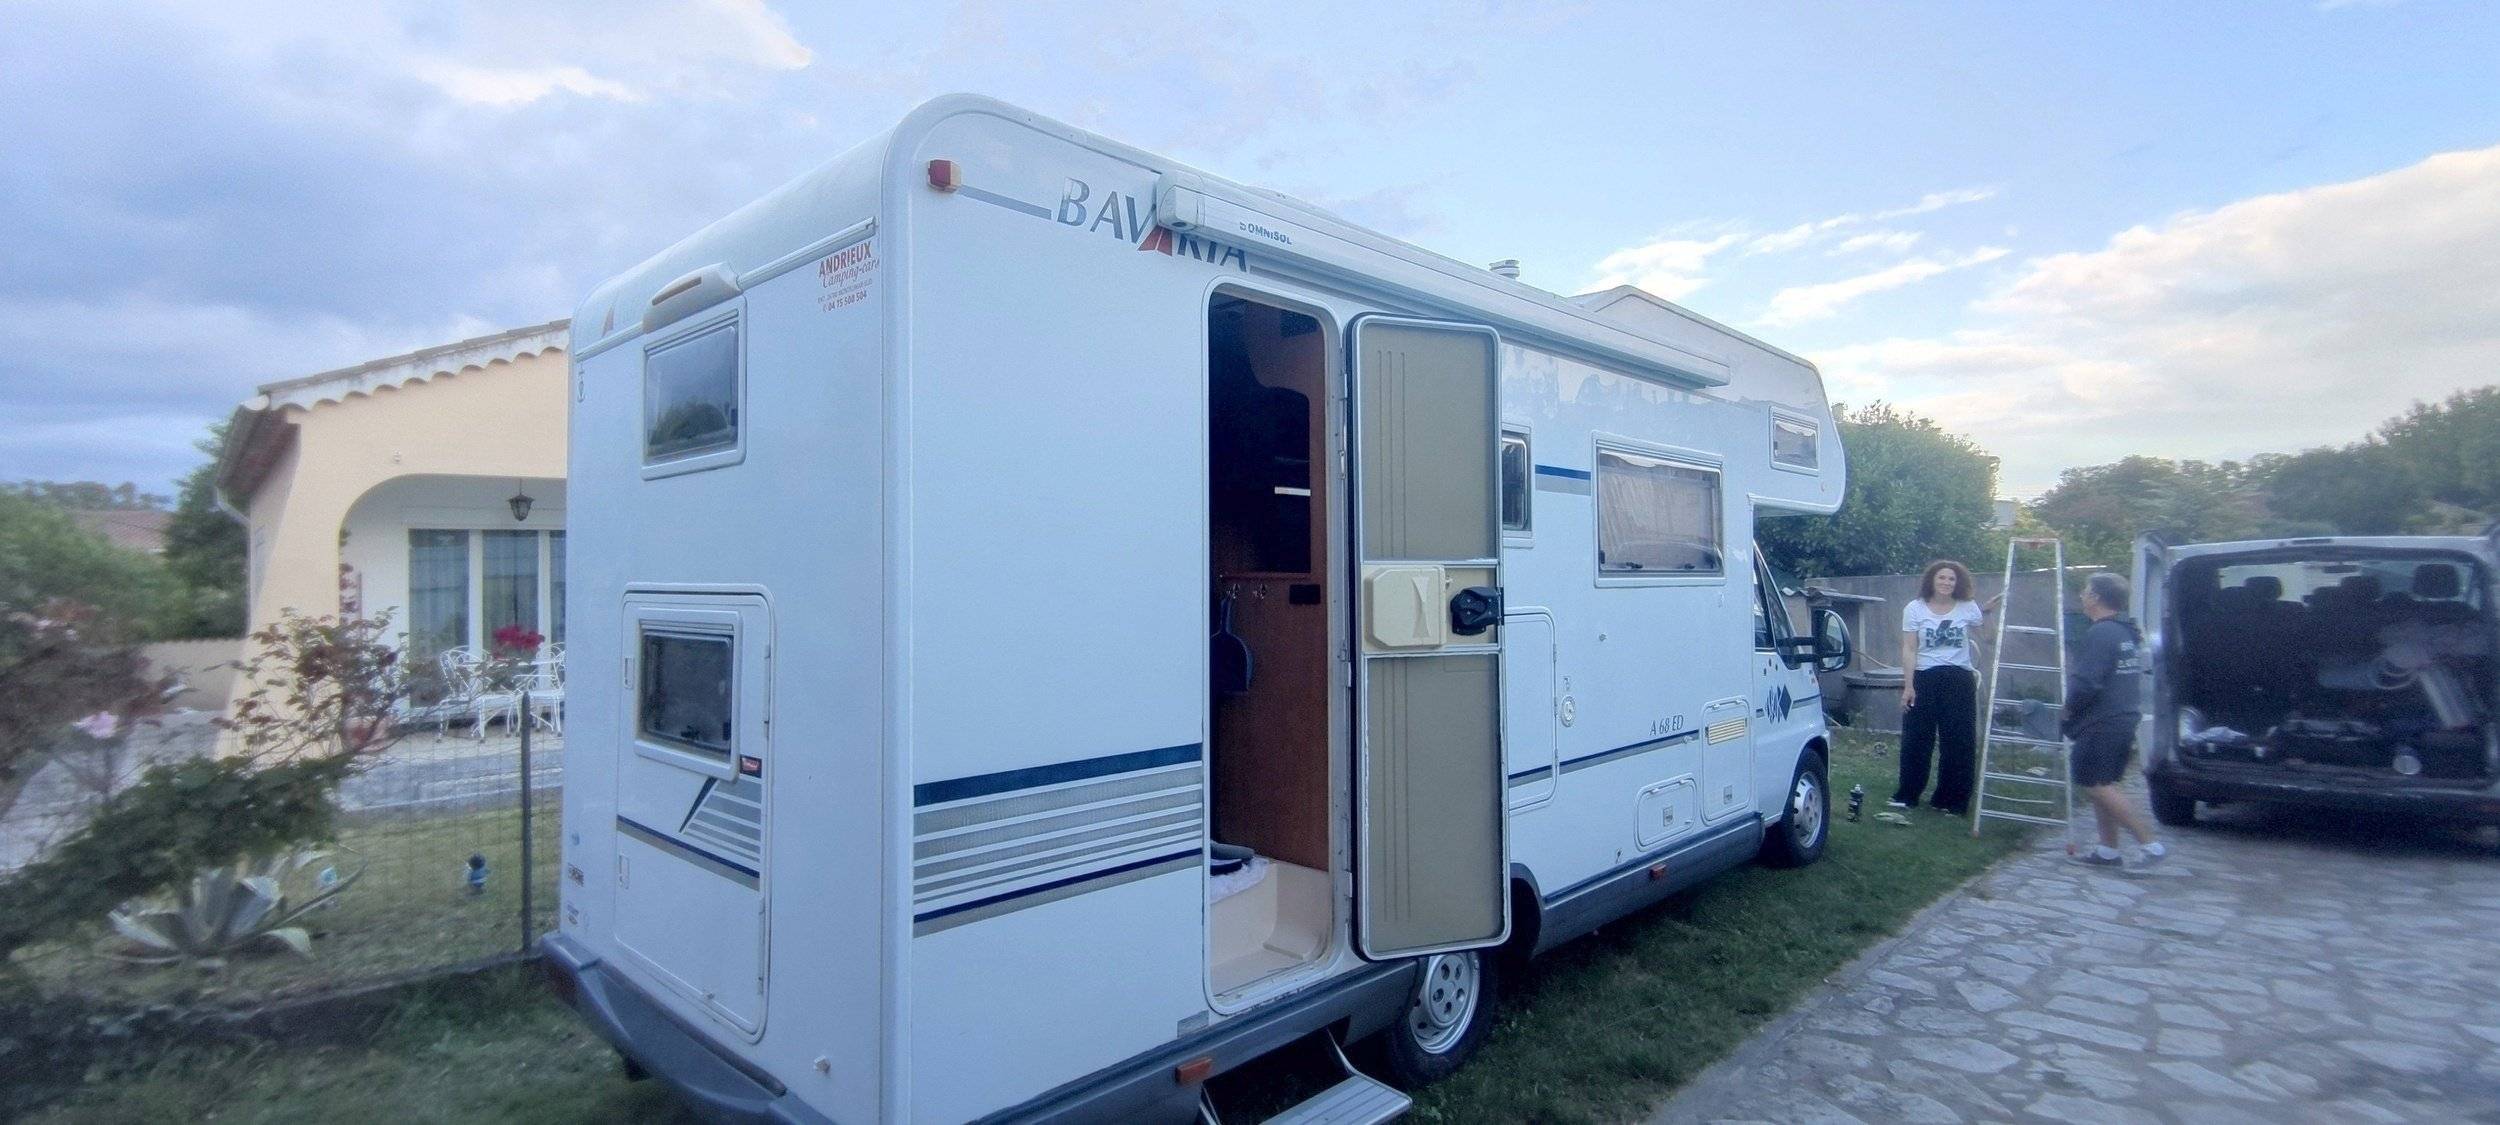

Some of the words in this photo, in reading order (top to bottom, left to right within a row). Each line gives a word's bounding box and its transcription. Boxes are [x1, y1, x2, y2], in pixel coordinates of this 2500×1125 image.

[819, 241, 871, 277] ANDRIEUX
[1649, 719, 1657, 736] A
[1659, 717, 1670, 734] 68
[1672, 714, 1684, 732] ED
